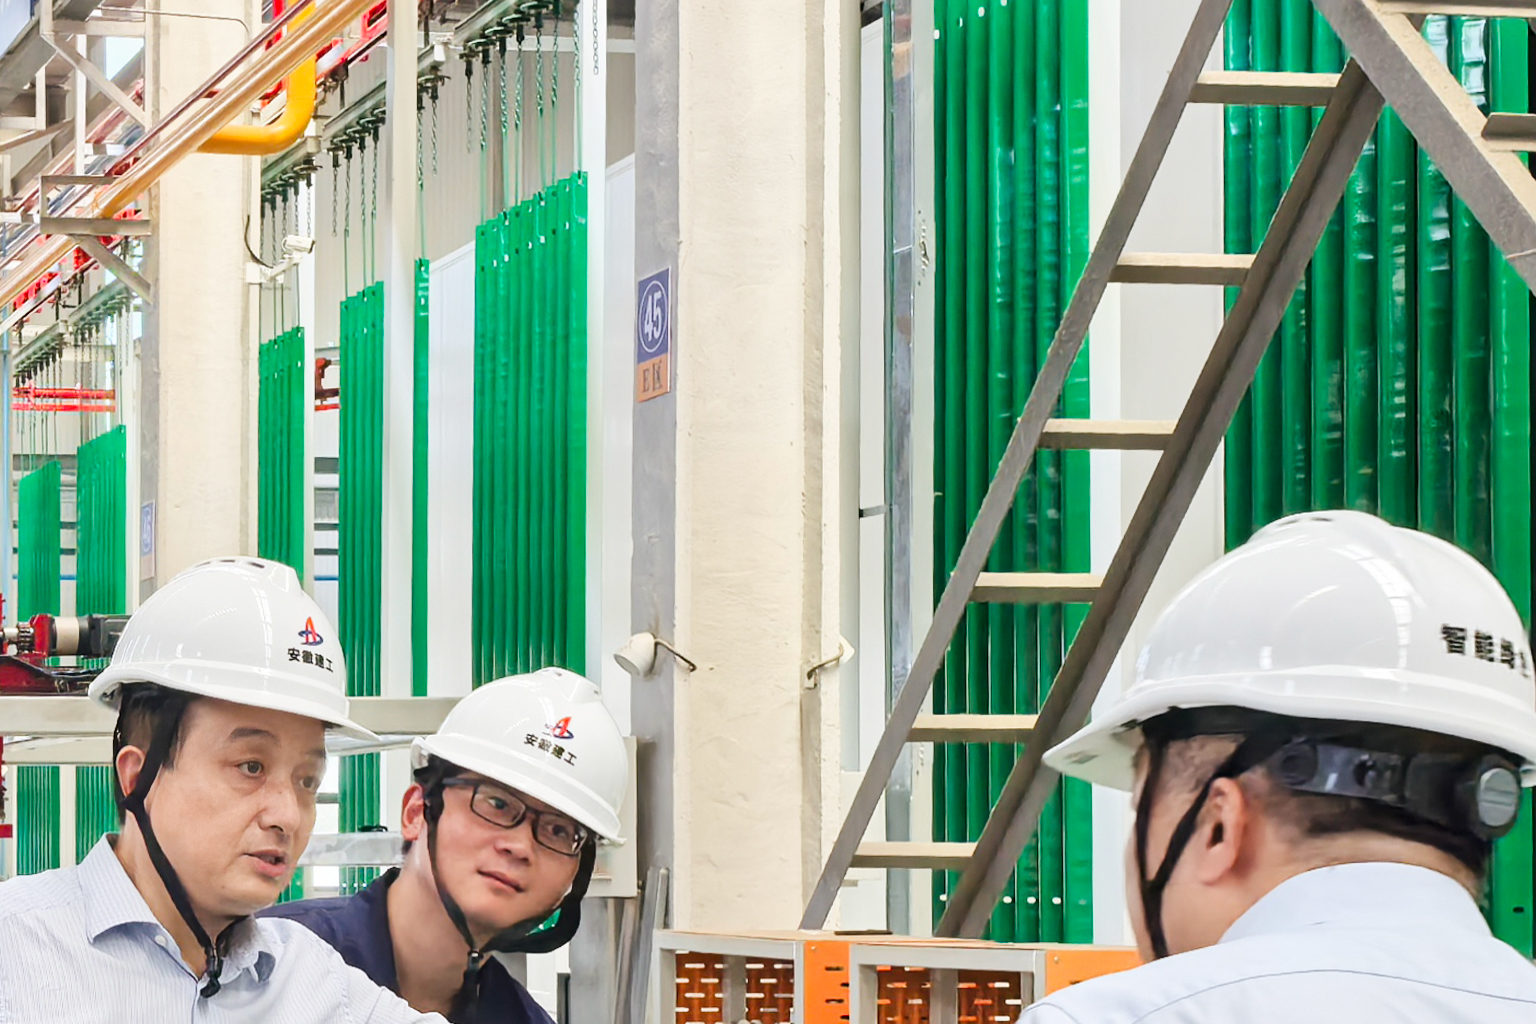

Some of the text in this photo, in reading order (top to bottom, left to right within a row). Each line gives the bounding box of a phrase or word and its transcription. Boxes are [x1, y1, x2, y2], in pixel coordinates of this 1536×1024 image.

[644, 290, 663, 341] 45
[286, 647, 334, 674] 安徽建工
[523, 733, 578, 767] 安徽建工
